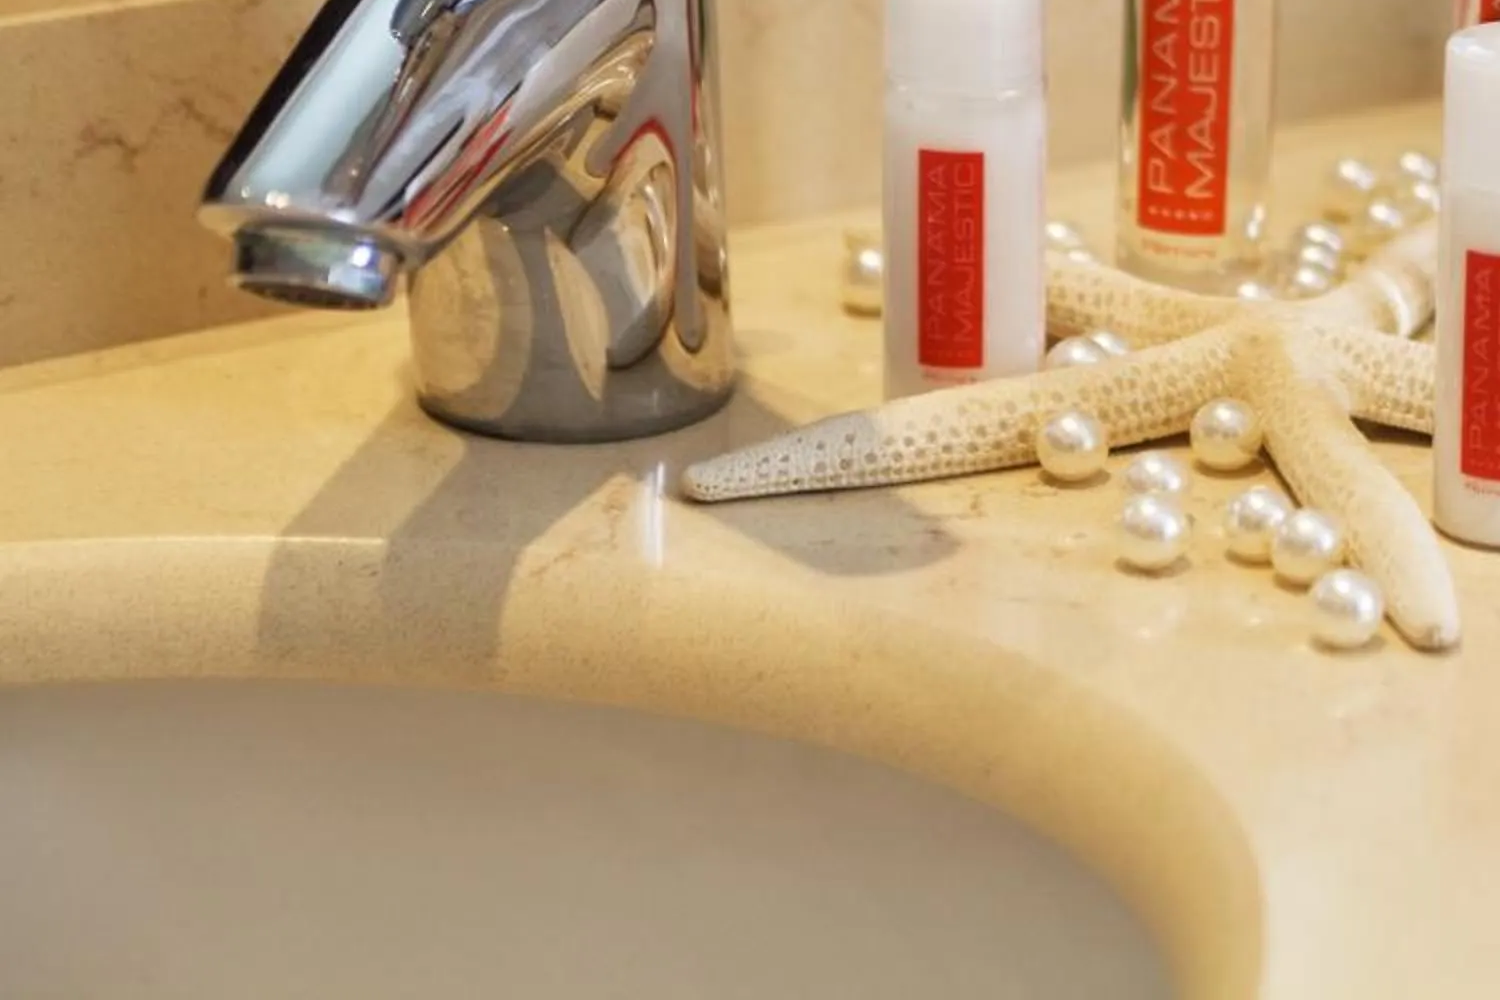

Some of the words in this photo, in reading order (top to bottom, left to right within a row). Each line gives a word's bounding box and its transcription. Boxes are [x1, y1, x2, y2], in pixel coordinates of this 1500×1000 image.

[926, 162, 948, 341] PANAMA
[952, 161, 976, 342] MAJESTIC
[1469, 266, 1493, 450] PANAMA
